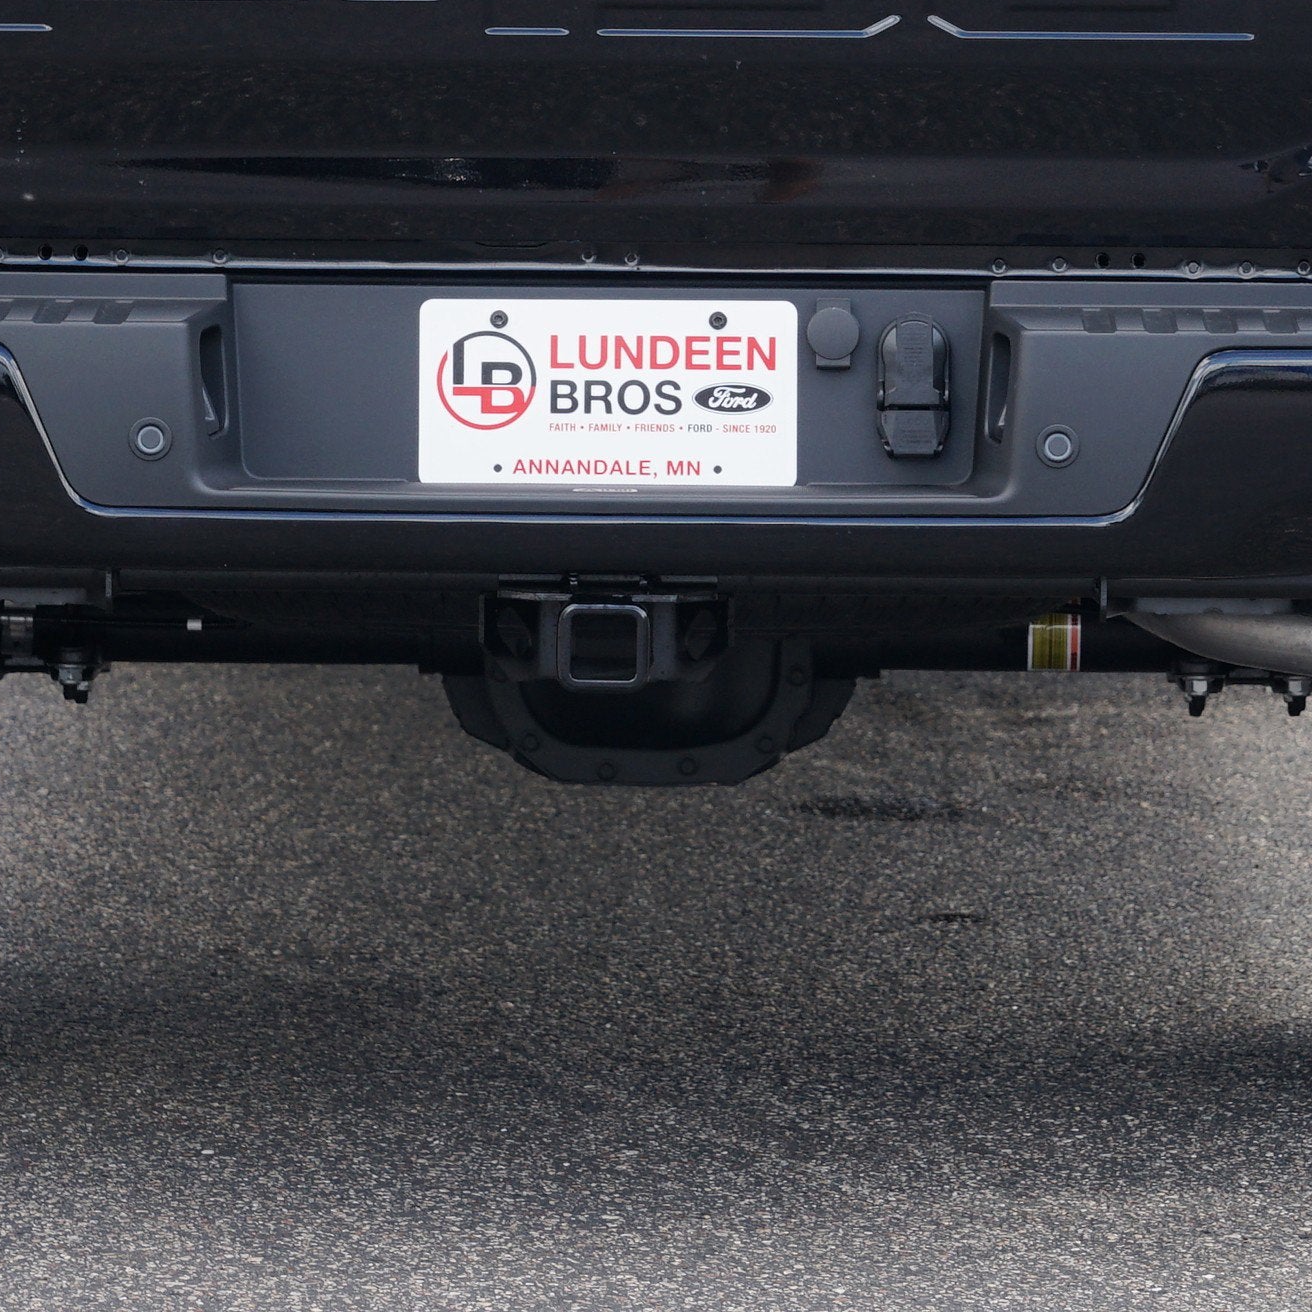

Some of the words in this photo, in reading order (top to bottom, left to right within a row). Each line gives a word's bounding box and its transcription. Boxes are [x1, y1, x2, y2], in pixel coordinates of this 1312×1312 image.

[549, 335, 777, 371] LUNDEEN
[549, 379, 683, 416] BROS
[707, 386, 758, 411] Ford
[549, 423, 576, 433] FAITH
[588, 423, 623, 433] FAMILY
[634, 423, 676, 433] FRIENDS
[687, 424, 713, 433] FORD
[722, 424, 751, 434] SINCE
[754, 424, 777, 434] 1920
[512, 459, 659, 477] ANNANDALE,
[666, 460, 701, 476] MN
